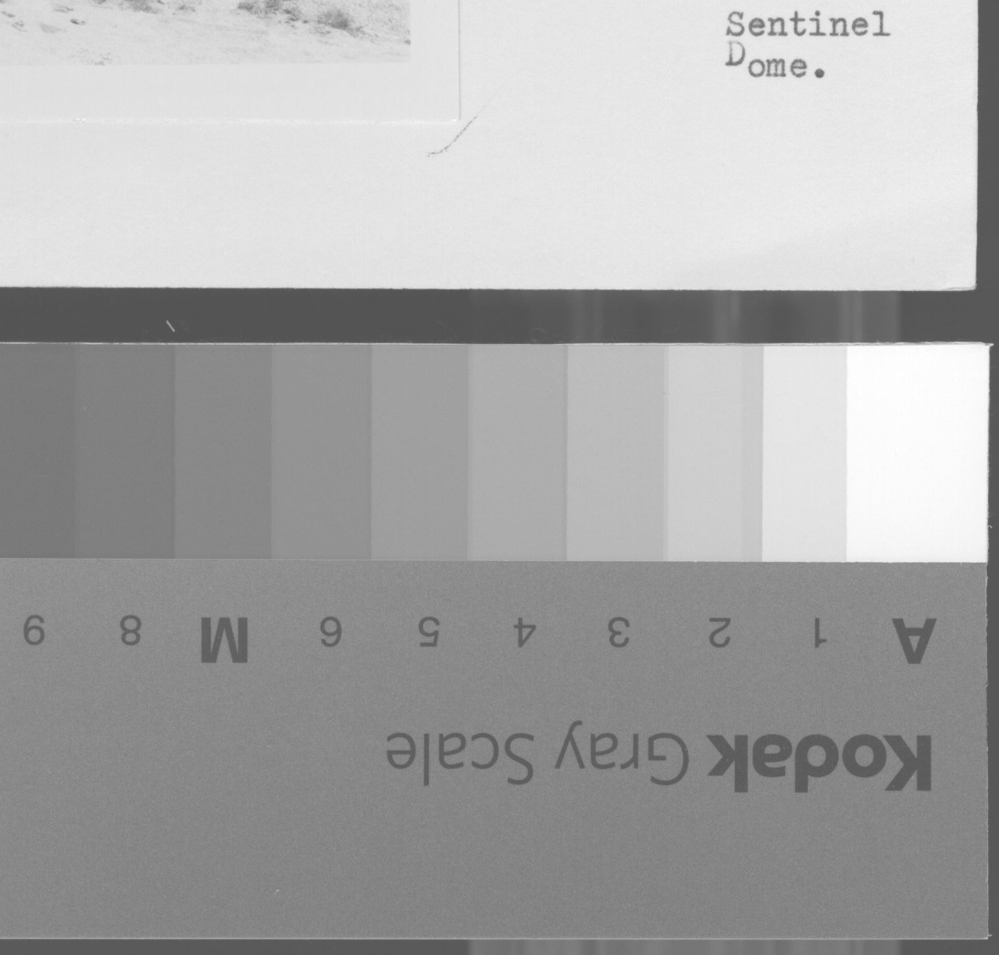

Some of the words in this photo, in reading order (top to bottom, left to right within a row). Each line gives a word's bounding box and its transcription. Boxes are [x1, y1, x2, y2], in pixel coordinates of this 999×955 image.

[725, 9, 891, 38] Sentinel
[724, 41, 826, 79] Dome.
[22, 614, 46, 646] 9
[119, 614, 143, 647] 8
[200, 616, 249, 664] M
[319, 615, 343, 648] 6
[417, 615, 441, 648] 5
[513, 616, 537, 649] 4
[607, 616, 631, 649] 3
[708, 617, 732, 649] 2
[814, 617, 828, 649] 1
[891, 617, 938, 665] A
[386, 731, 535, 787] Scale
[554, 719, 690, 787] Gray
[706, 733, 932, 794] Kodak
